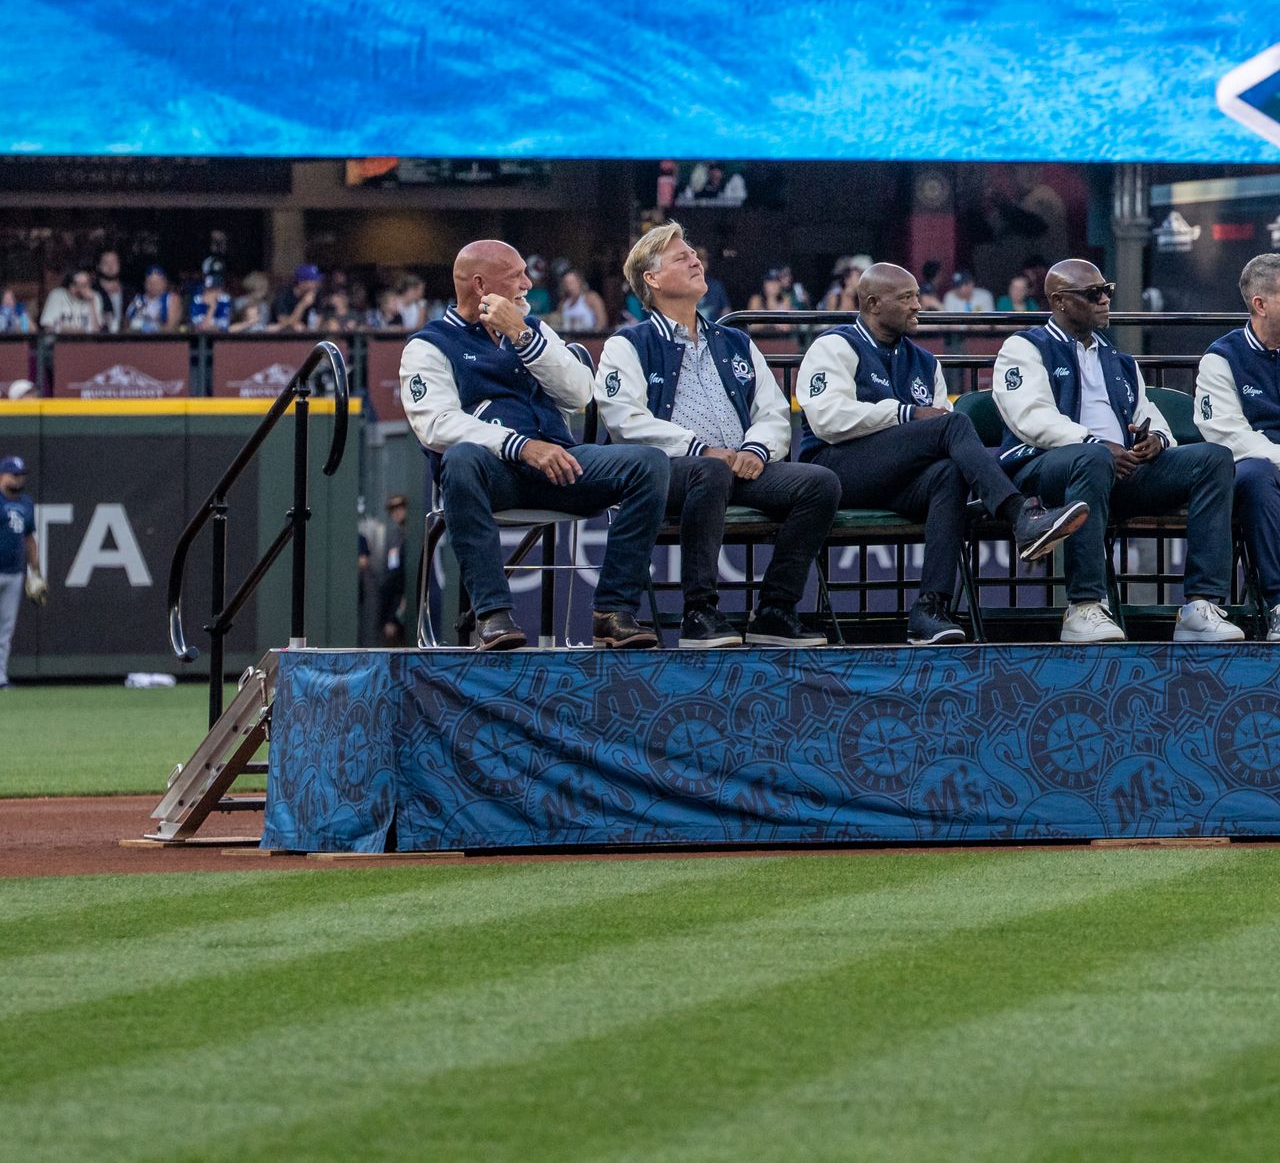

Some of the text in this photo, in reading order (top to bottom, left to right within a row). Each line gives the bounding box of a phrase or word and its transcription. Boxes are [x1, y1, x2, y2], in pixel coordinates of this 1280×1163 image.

[734, 362, 749, 374] 50
[1052, 367, 1070, 379] Mike
[914, 383, 928, 396] 50
[1242, 385, 1263, 397] Edgar
